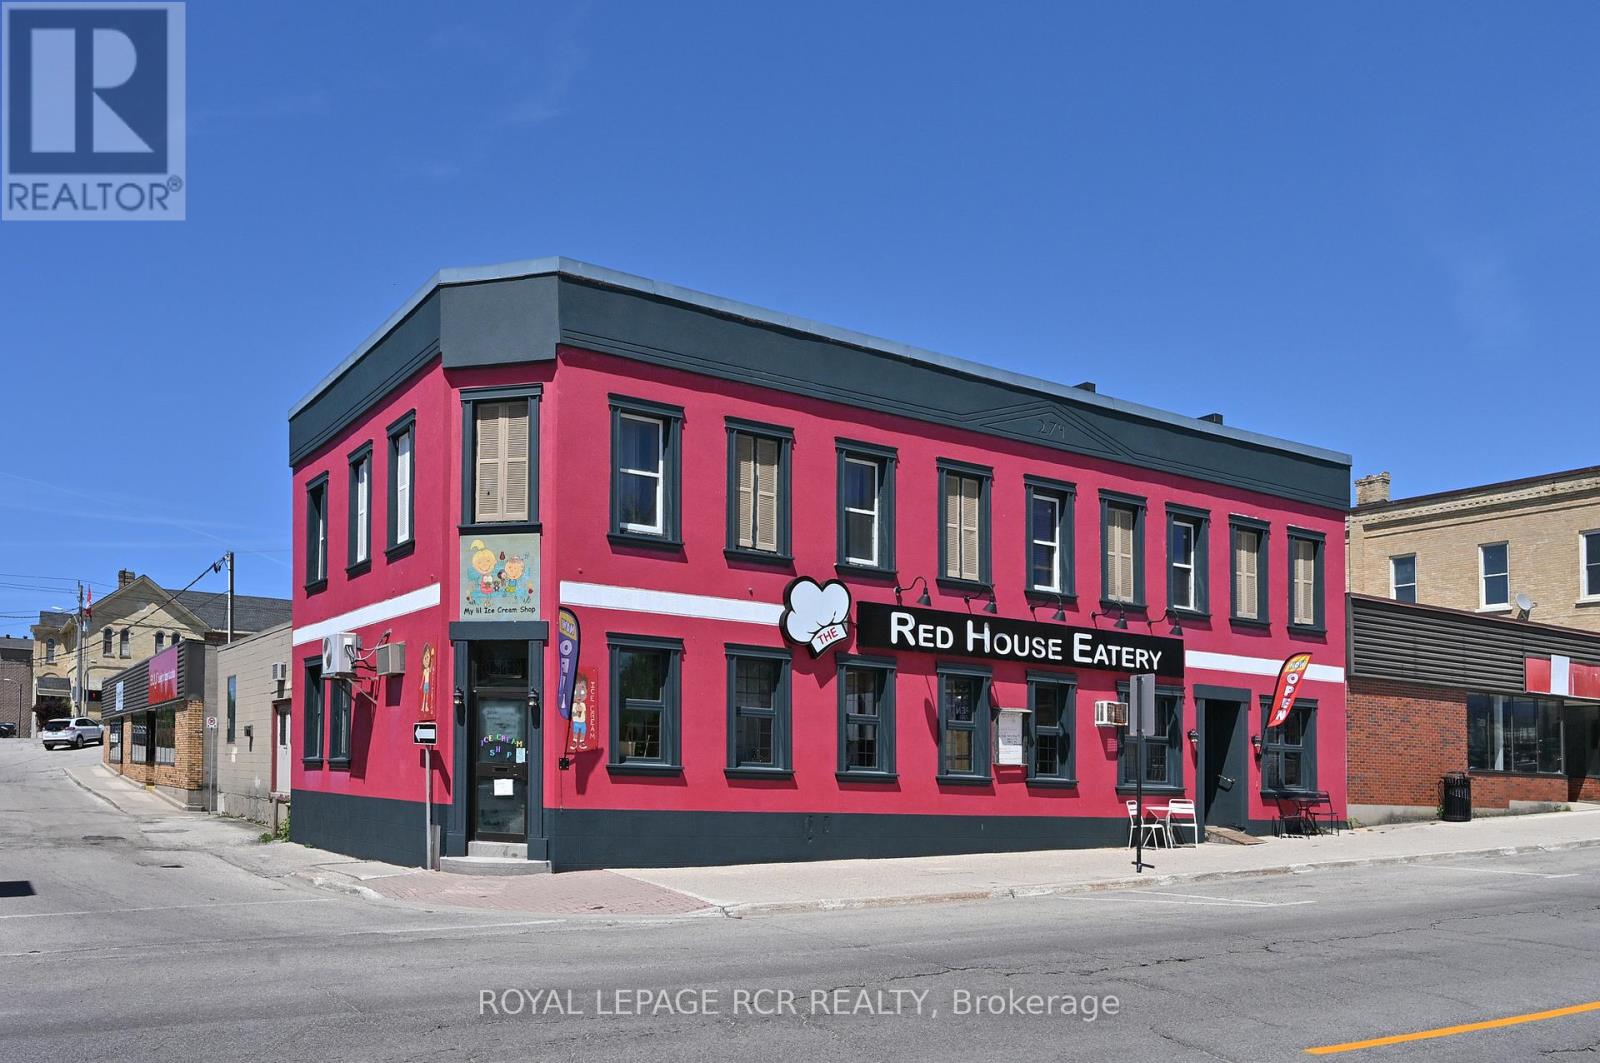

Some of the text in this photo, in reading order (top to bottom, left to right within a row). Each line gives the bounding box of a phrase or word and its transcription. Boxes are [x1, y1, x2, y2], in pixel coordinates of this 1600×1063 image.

[463, 607, 473, 615] My
[497, 606, 518, 614] Cream
[520, 606, 536, 614] Shop
[817, 627, 838, 645] THE
[889, 611, 1163, 670] RED HOUSE EATERY
[1275, 672, 1299, 721] OPEN
[480, 734, 494, 747] ICE
